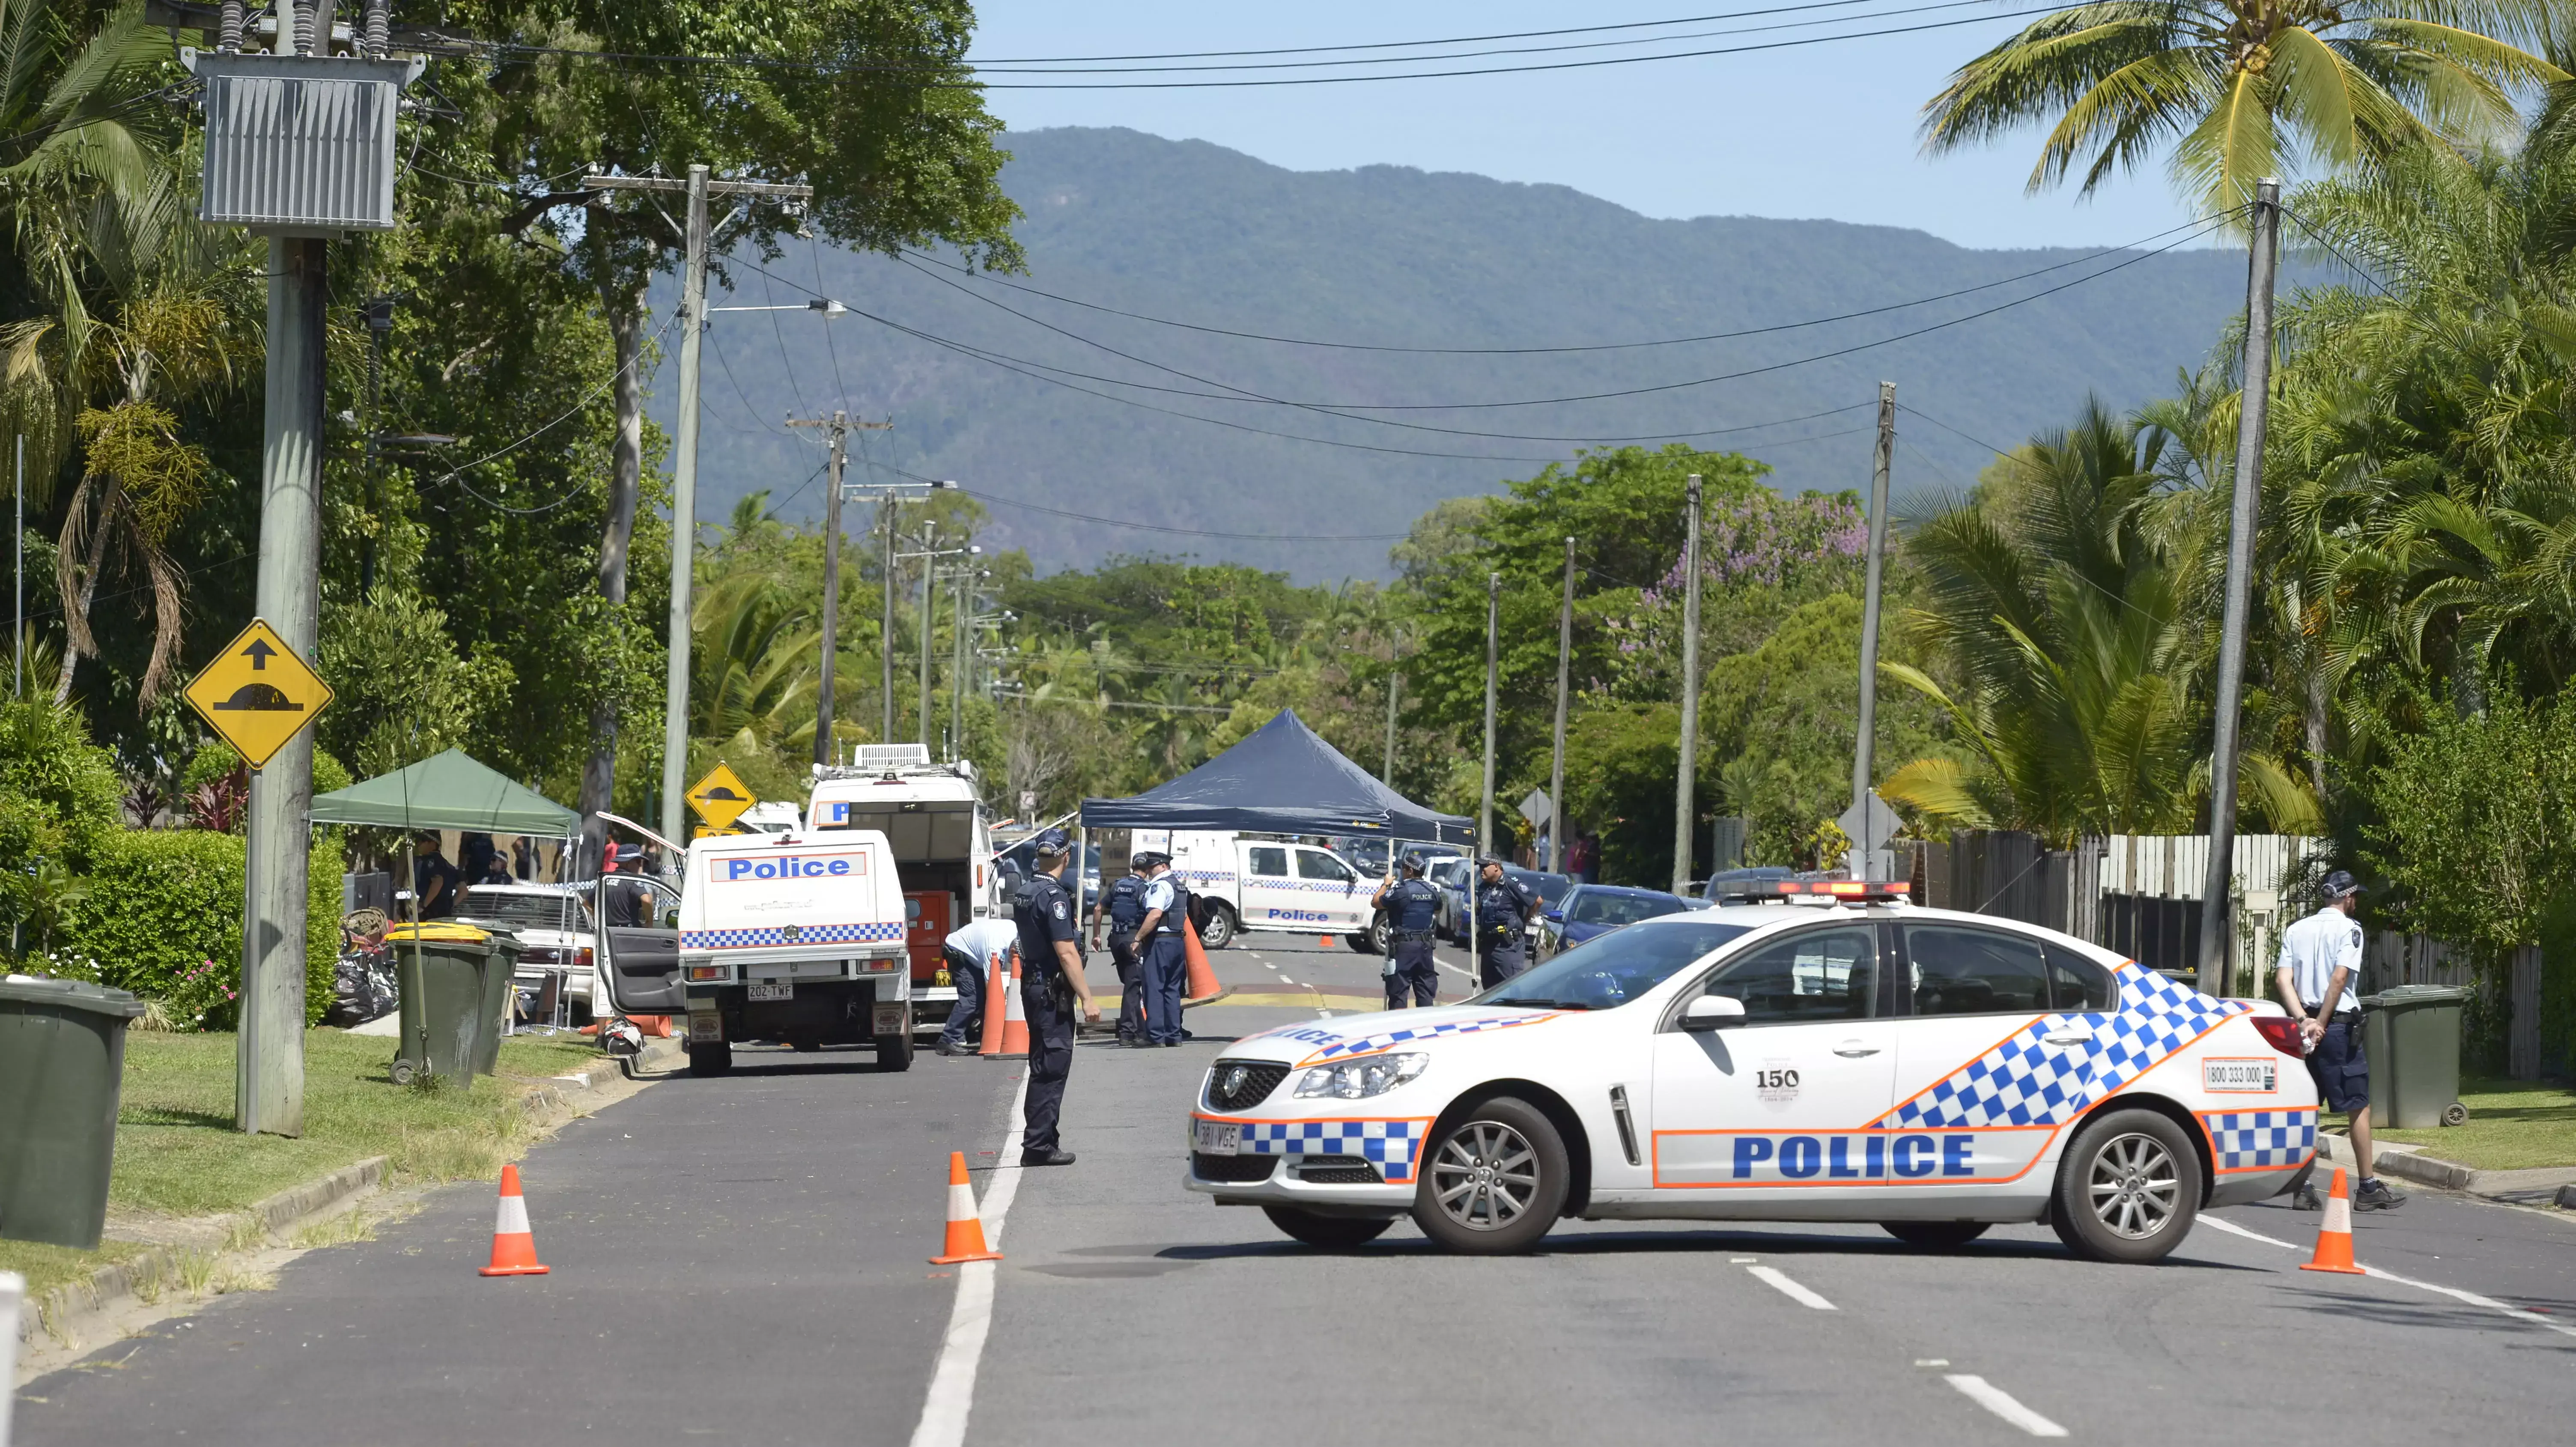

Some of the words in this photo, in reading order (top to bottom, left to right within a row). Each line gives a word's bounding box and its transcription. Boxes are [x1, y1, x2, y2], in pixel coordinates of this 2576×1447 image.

[729, 857, 850, 880] Police
[1268, 908, 1329, 921] Police
[1756, 1069, 1800, 1088] 150
[2206, 1066, 2226, 1083] 1800
[2229, 1066, 2243, 1083] 333
[2246, 1066, 2261, 1083] 000
[1733, 1135, 1974, 1178] POLICE
